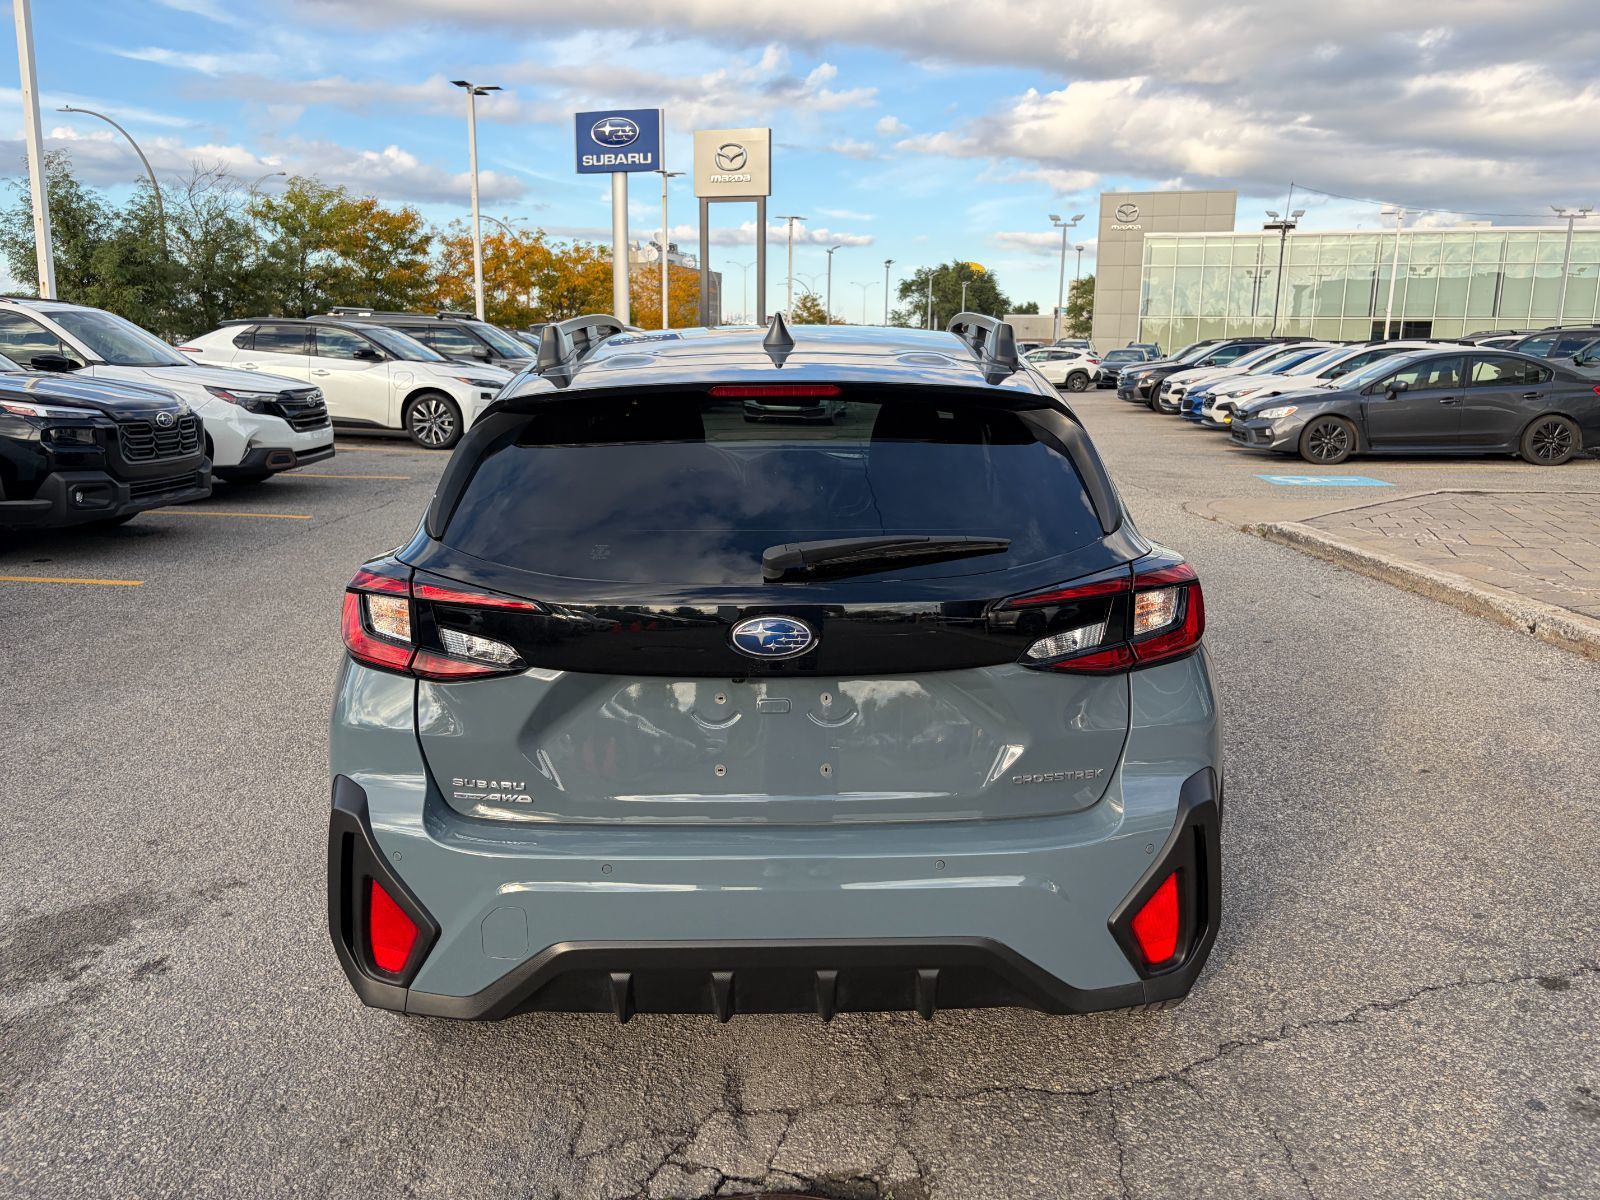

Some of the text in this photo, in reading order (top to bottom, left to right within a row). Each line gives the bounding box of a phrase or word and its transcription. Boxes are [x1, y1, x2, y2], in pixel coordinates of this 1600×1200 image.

[582, 152, 652, 166] SUBARU
[1012, 768, 1104, 784] CROSSTREK
[452, 777, 526, 791] SUBARU
[483, 793, 534, 803] AWD
